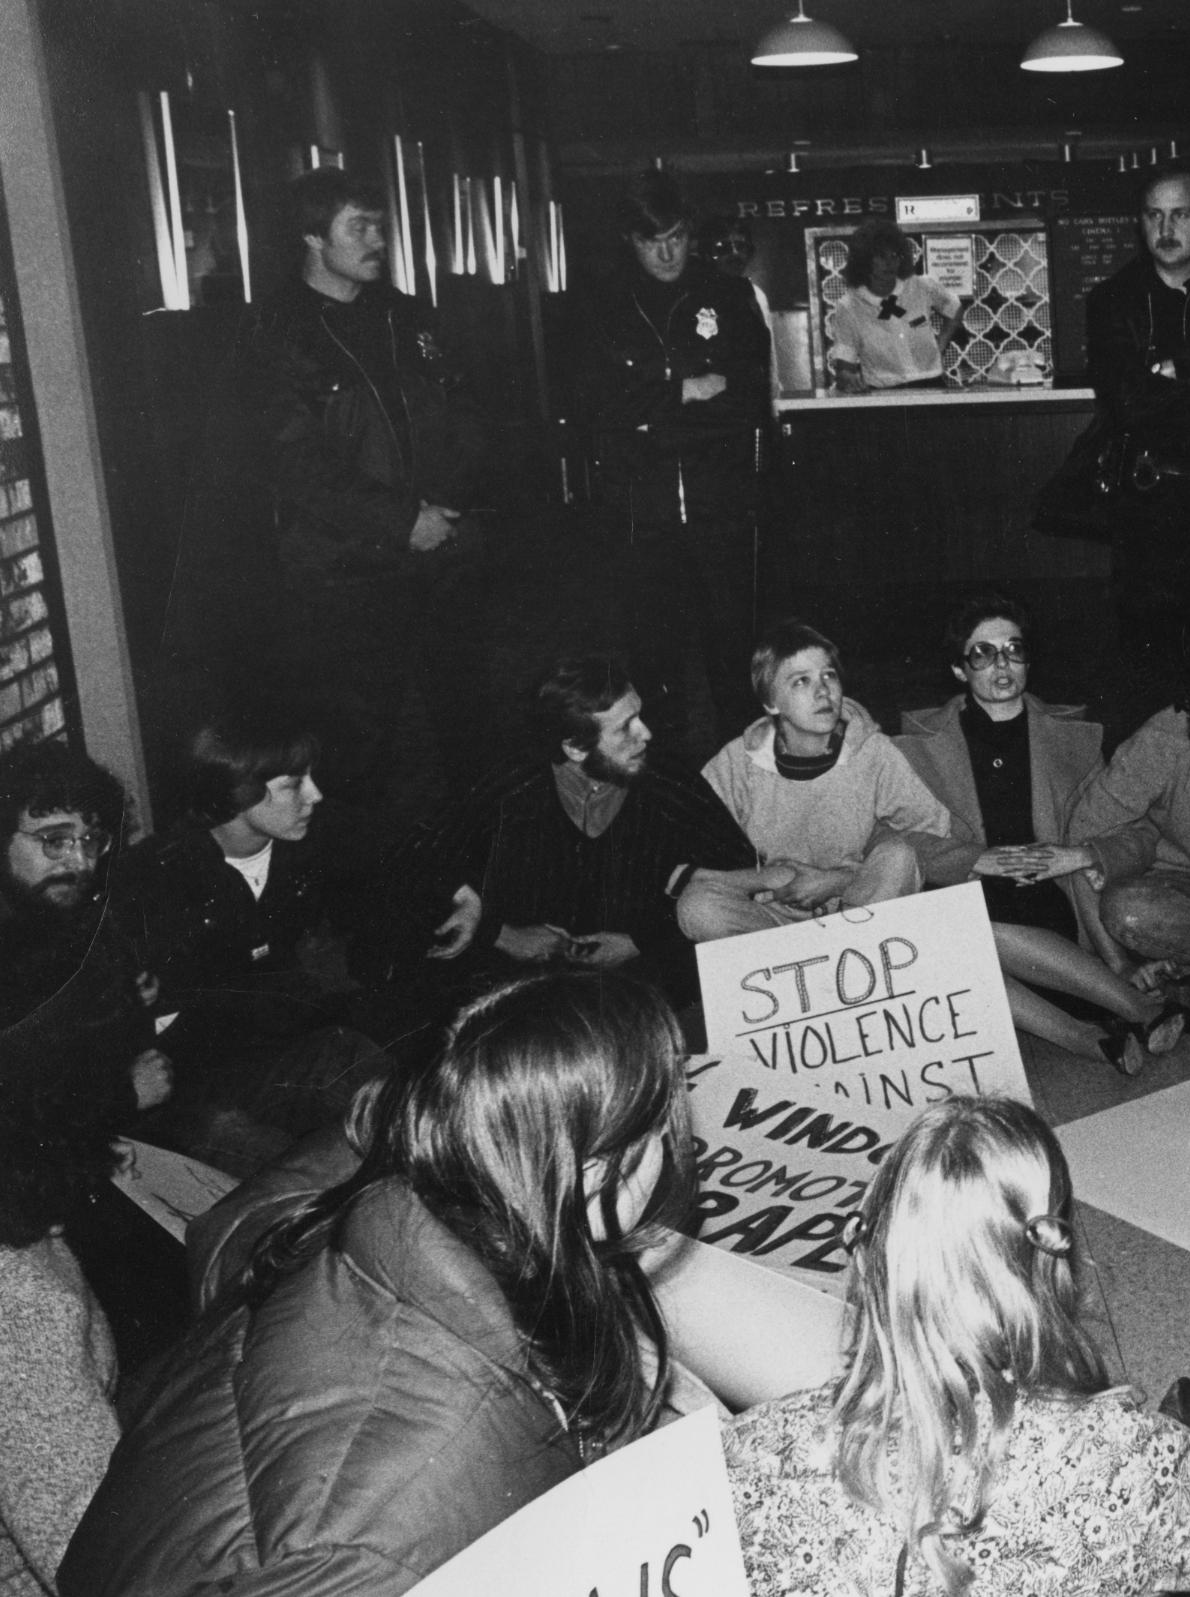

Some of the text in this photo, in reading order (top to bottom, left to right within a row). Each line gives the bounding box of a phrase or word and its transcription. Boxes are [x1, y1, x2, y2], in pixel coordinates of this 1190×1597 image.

[737, 190, 1069, 218] REFRESNTS
[741, 936, 918, 1024] STOP
[833, 1051, 994, 1108] INST
[691, 1136, 868, 1208] PROMOT
